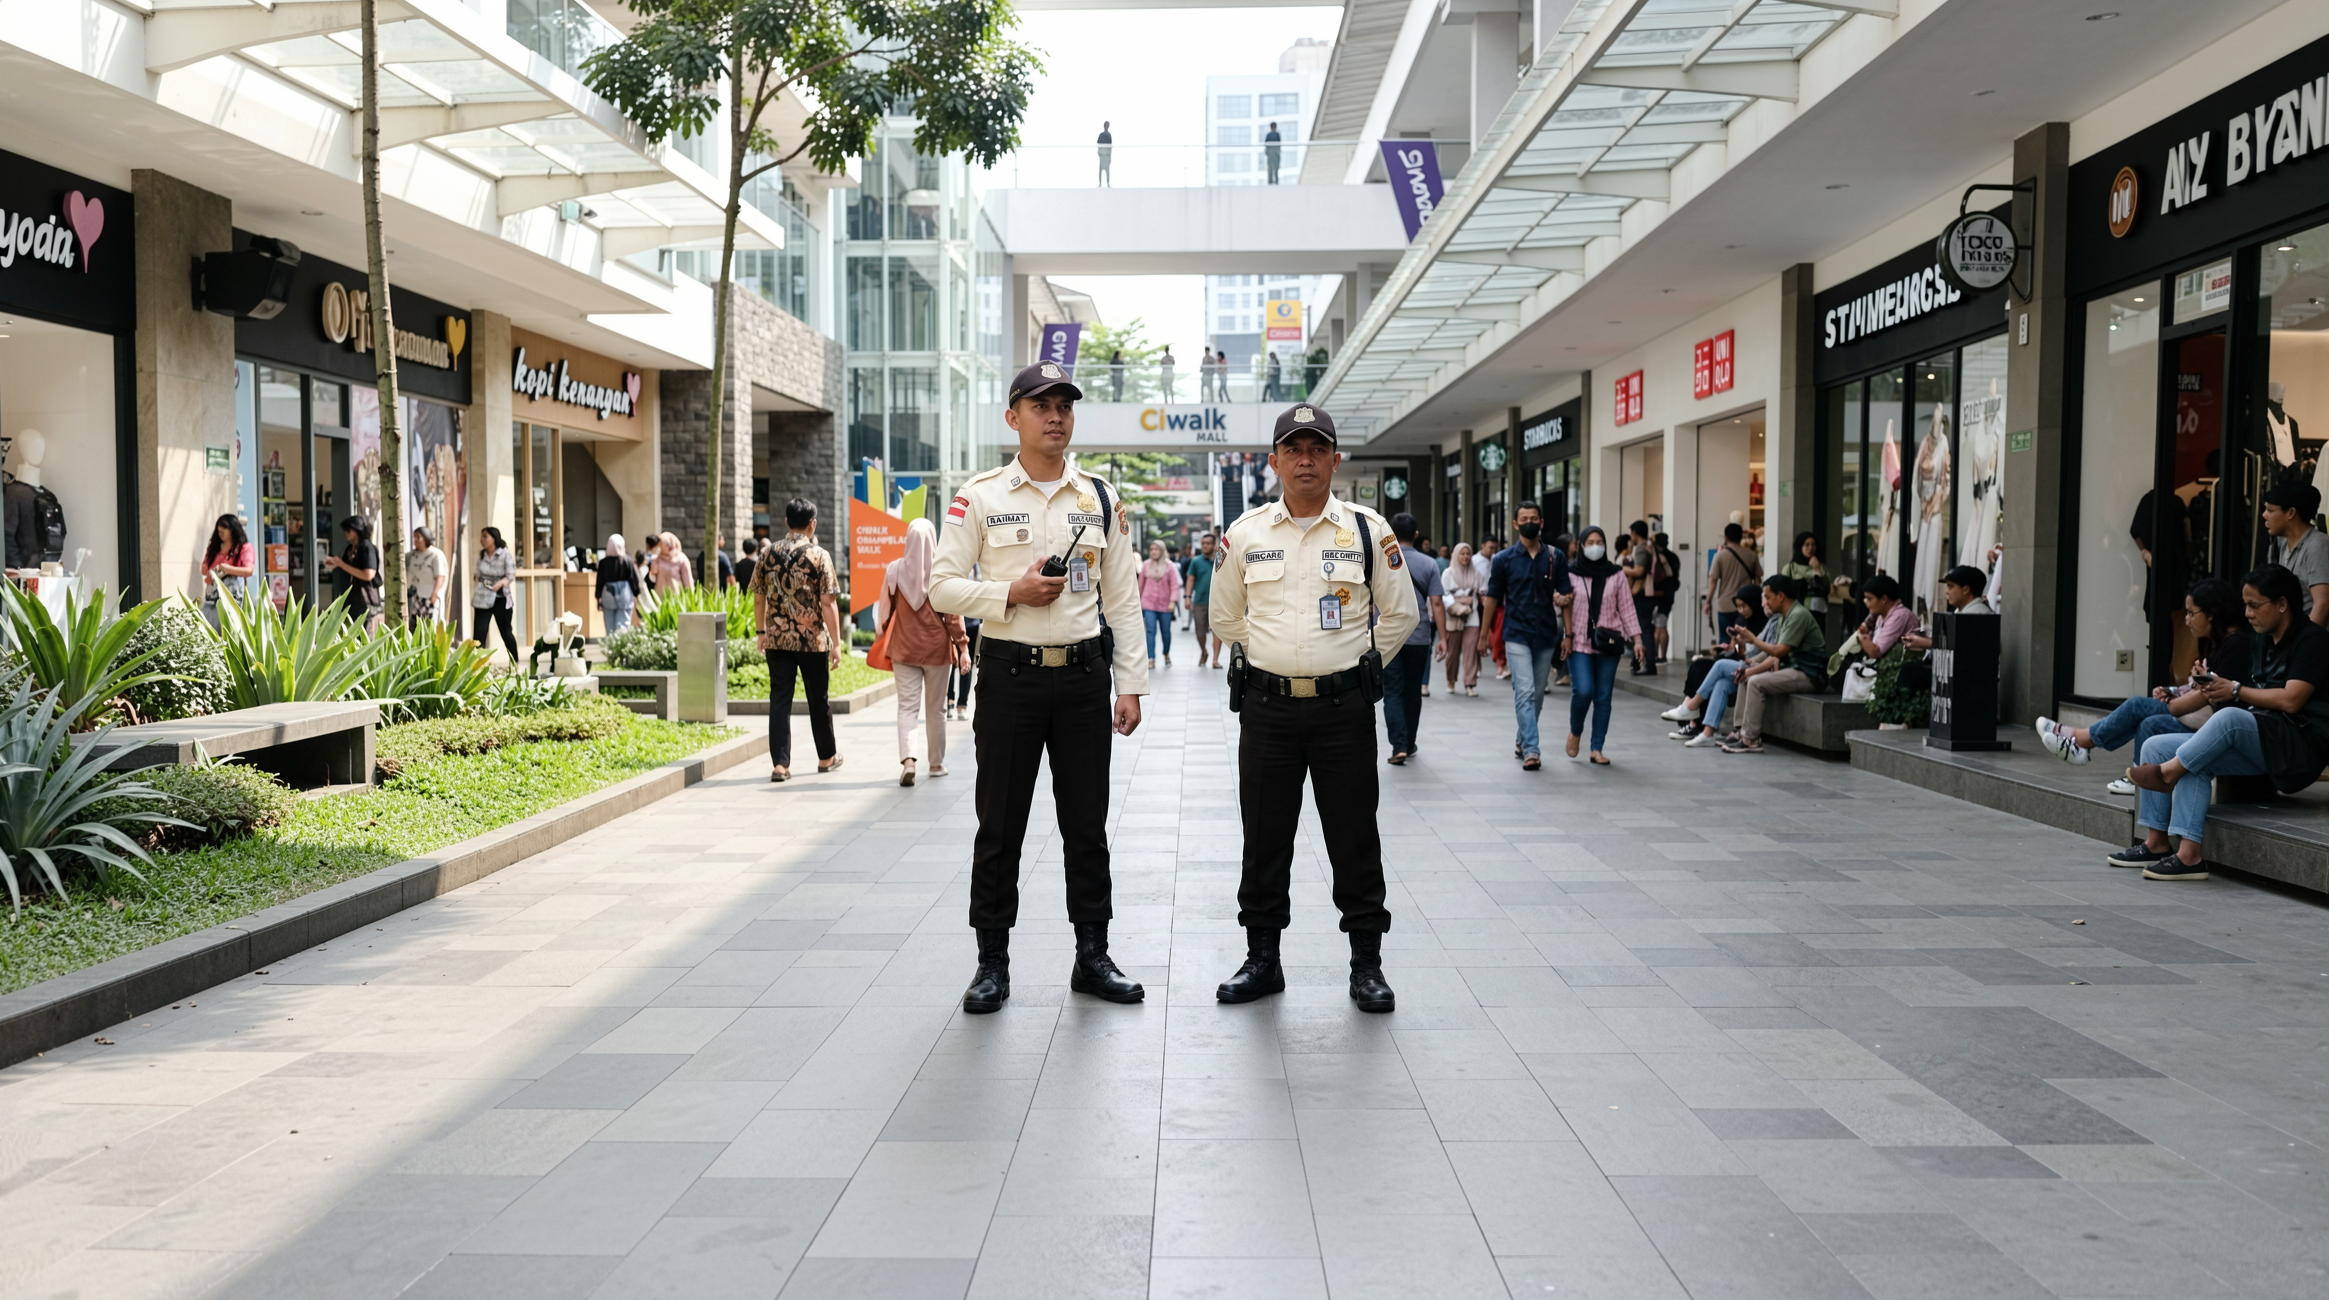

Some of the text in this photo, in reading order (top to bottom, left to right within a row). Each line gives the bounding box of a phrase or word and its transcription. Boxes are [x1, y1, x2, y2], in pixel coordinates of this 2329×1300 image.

[513, 346, 555, 401] kopi
[1140, 408, 1227, 431] Ciwalk
[1196, 432, 1228, 442] MALL
